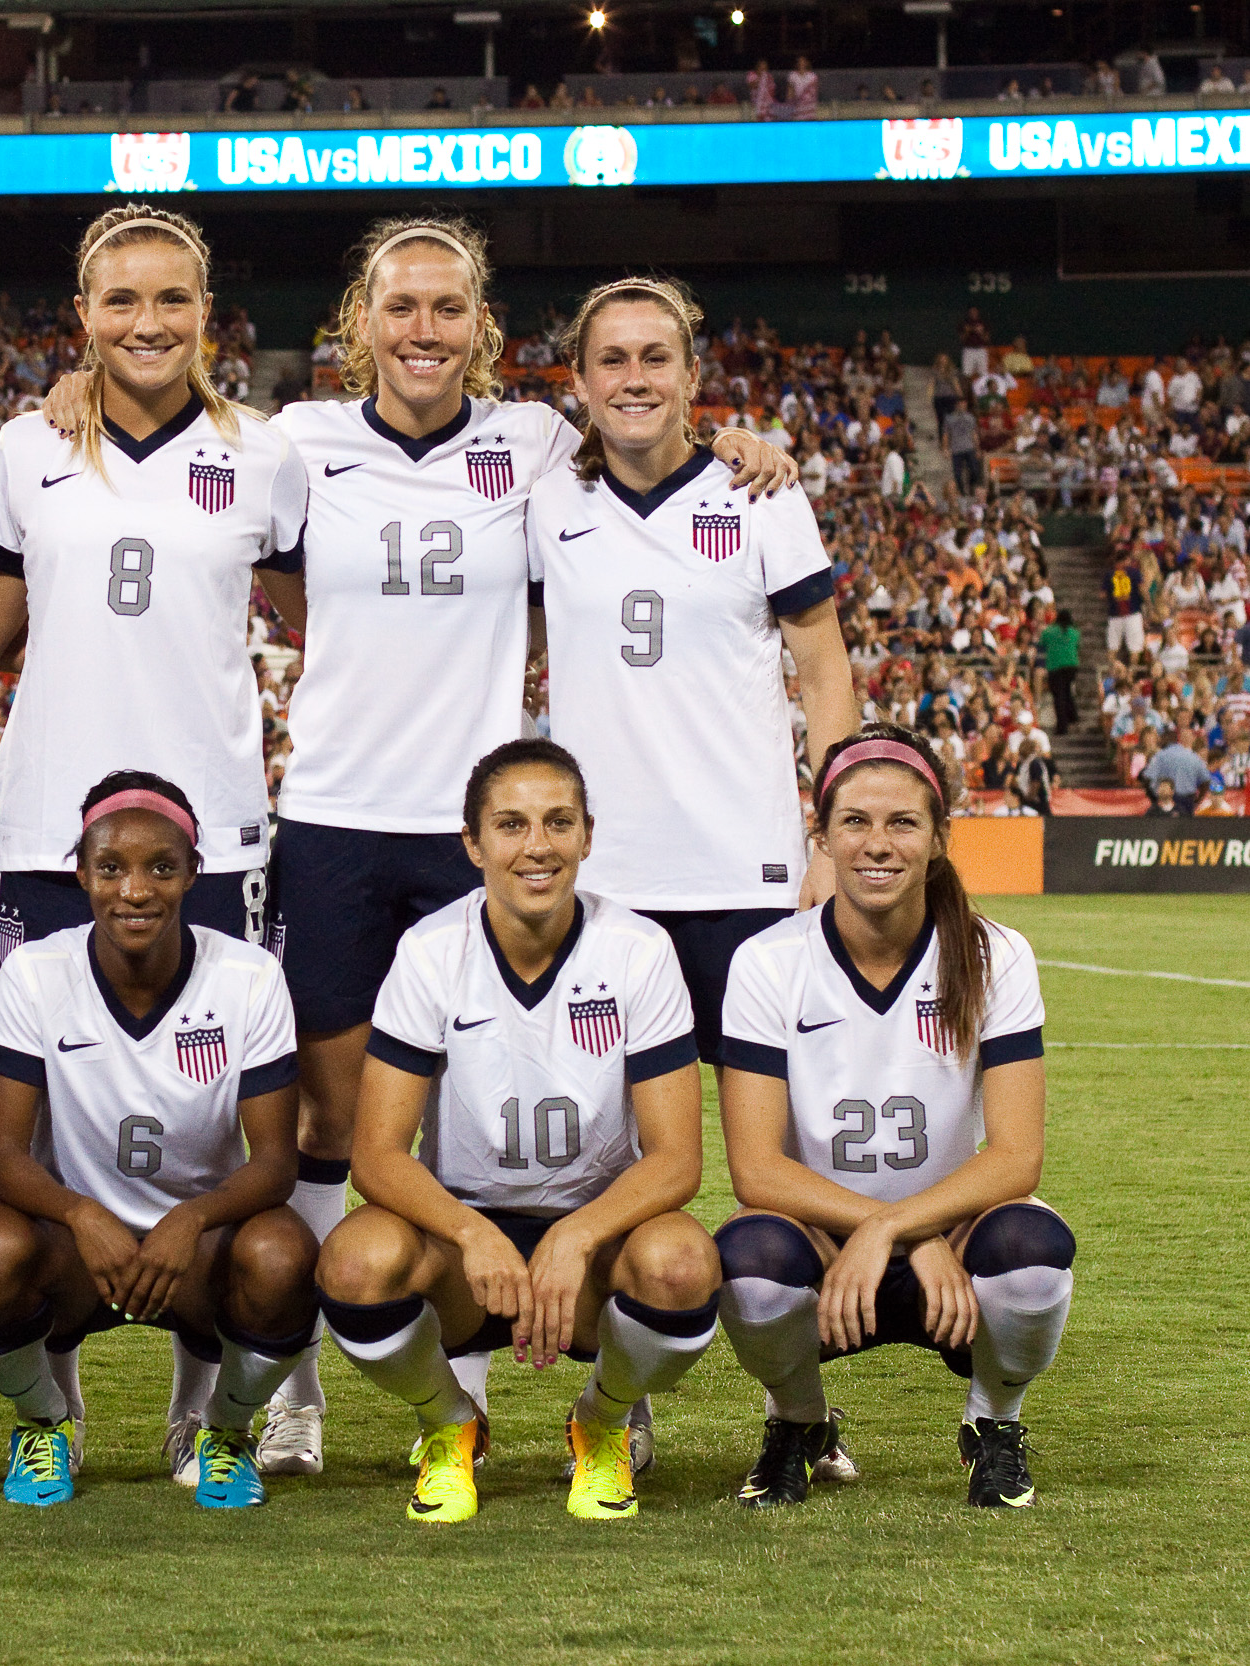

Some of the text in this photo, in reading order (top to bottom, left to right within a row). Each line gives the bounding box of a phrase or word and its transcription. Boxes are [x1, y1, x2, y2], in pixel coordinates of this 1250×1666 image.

[846, 273, 887, 294] 334
[968, 273, 1012, 294] 335
[108, 537, 154, 616] 8
[380, 520, 464, 595] 12
[620, 590, 664, 667] 9
[1094, 839, 1159, 866] FIND
[1160, 839, 1225, 866] NEW
[242, 869, 267, 944] 8
[117, 1114, 164, 1178] 6
[498, 1096, 581, 1170] 10
[832, 1096, 929, 1173] 23
